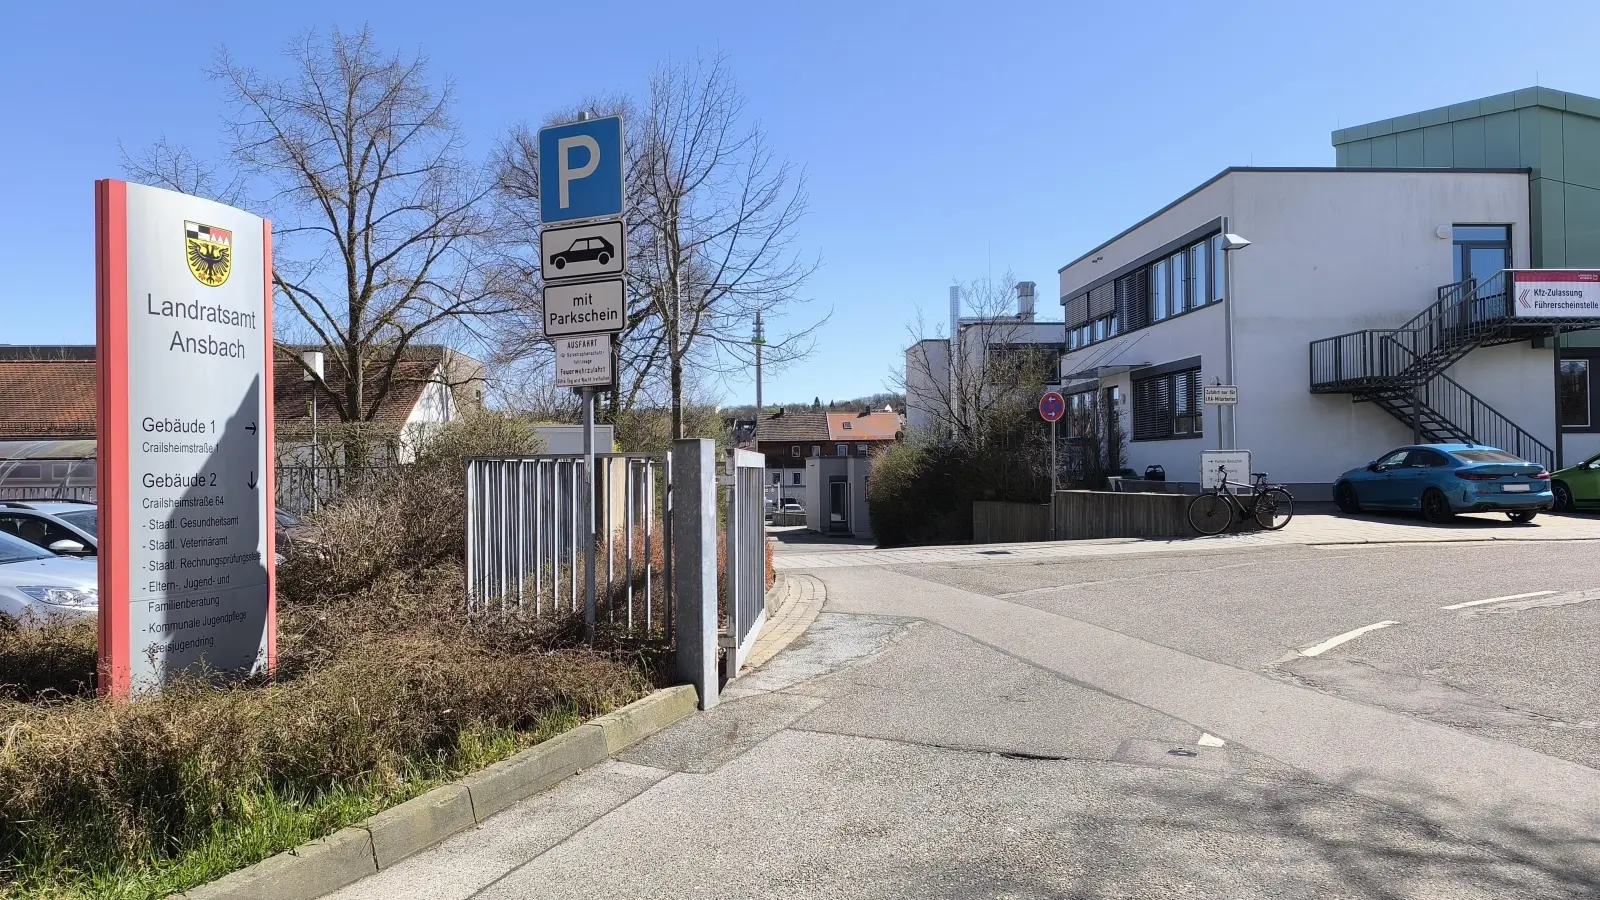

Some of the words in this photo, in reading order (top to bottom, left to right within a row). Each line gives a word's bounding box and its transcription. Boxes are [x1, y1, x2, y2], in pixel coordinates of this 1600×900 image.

[558, 134, 600, 208] P
[573, 293, 593, 307] mit
[1534, 288, 1582, 298] Kfz-Zulassung
[148, 293, 256, 330] Landratsamt
[550, 307, 618, 326] Parkschein
[170, 330, 245, 359] Ansbach
[567, 339, 597, 349] AUSFAHRT
[142, 417, 205, 433] Gebäude
[211, 420, 215, 433] 1
[142, 442, 214, 454] Crailsheimstraße
[142, 473, 206, 488] Gebäude
[210, 473, 216, 486] 2
[142, 496, 213, 509] Crailsheimstraße
[215, 496, 224, 506] 64
[149, 518, 177, 530] Staatl.
[180, 516, 239, 528] Gesundheitsamt
[149, 539, 177, 550] Staatl.
[180, 536, 228, 548] Veterinäramt
[149, 560, 177, 572] Staatl.
[149, 581, 181, 592] Eltern-,
[184, 576, 215, 590] Jugend-
[217, 574, 230, 584] und
[148, 596, 220, 612] Familienberatung
[149, 617, 200, 634] Kommunale
[202, 611, 246, 628] Jugendpflege
